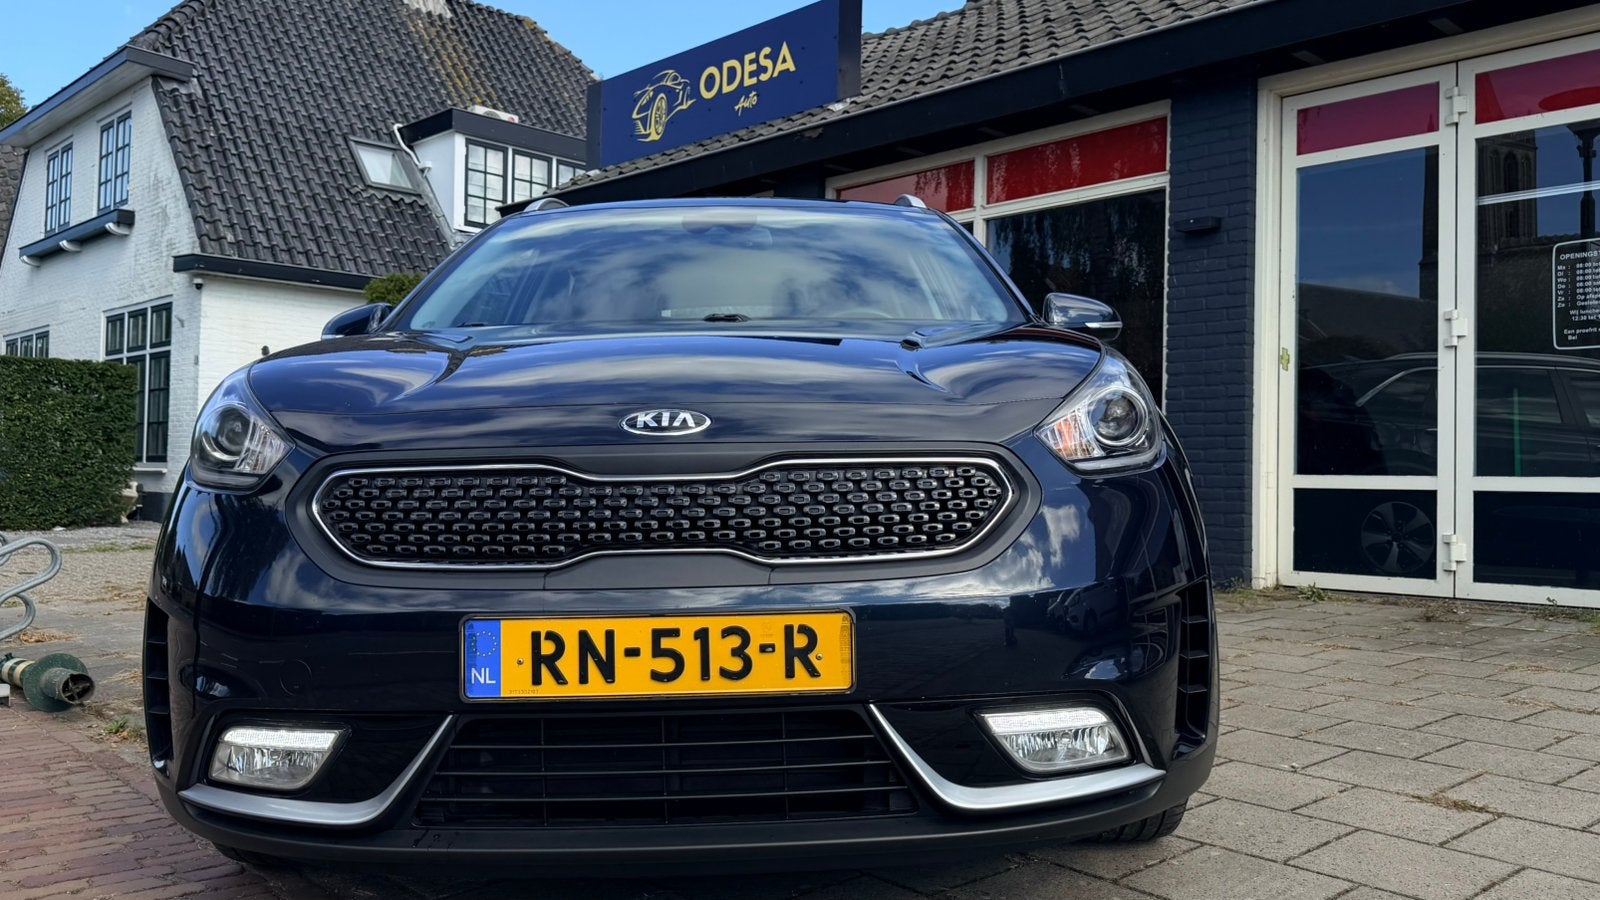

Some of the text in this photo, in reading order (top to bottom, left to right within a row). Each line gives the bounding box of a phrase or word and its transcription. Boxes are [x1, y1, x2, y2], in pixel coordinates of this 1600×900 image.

[700, 41, 796, 100] ODESA
[734, 91, 758, 116] Auto
[636, 411, 696, 428] KIA
[531, 623, 822, 686] RN-513-R
[471, 667, 496, 684] NL
